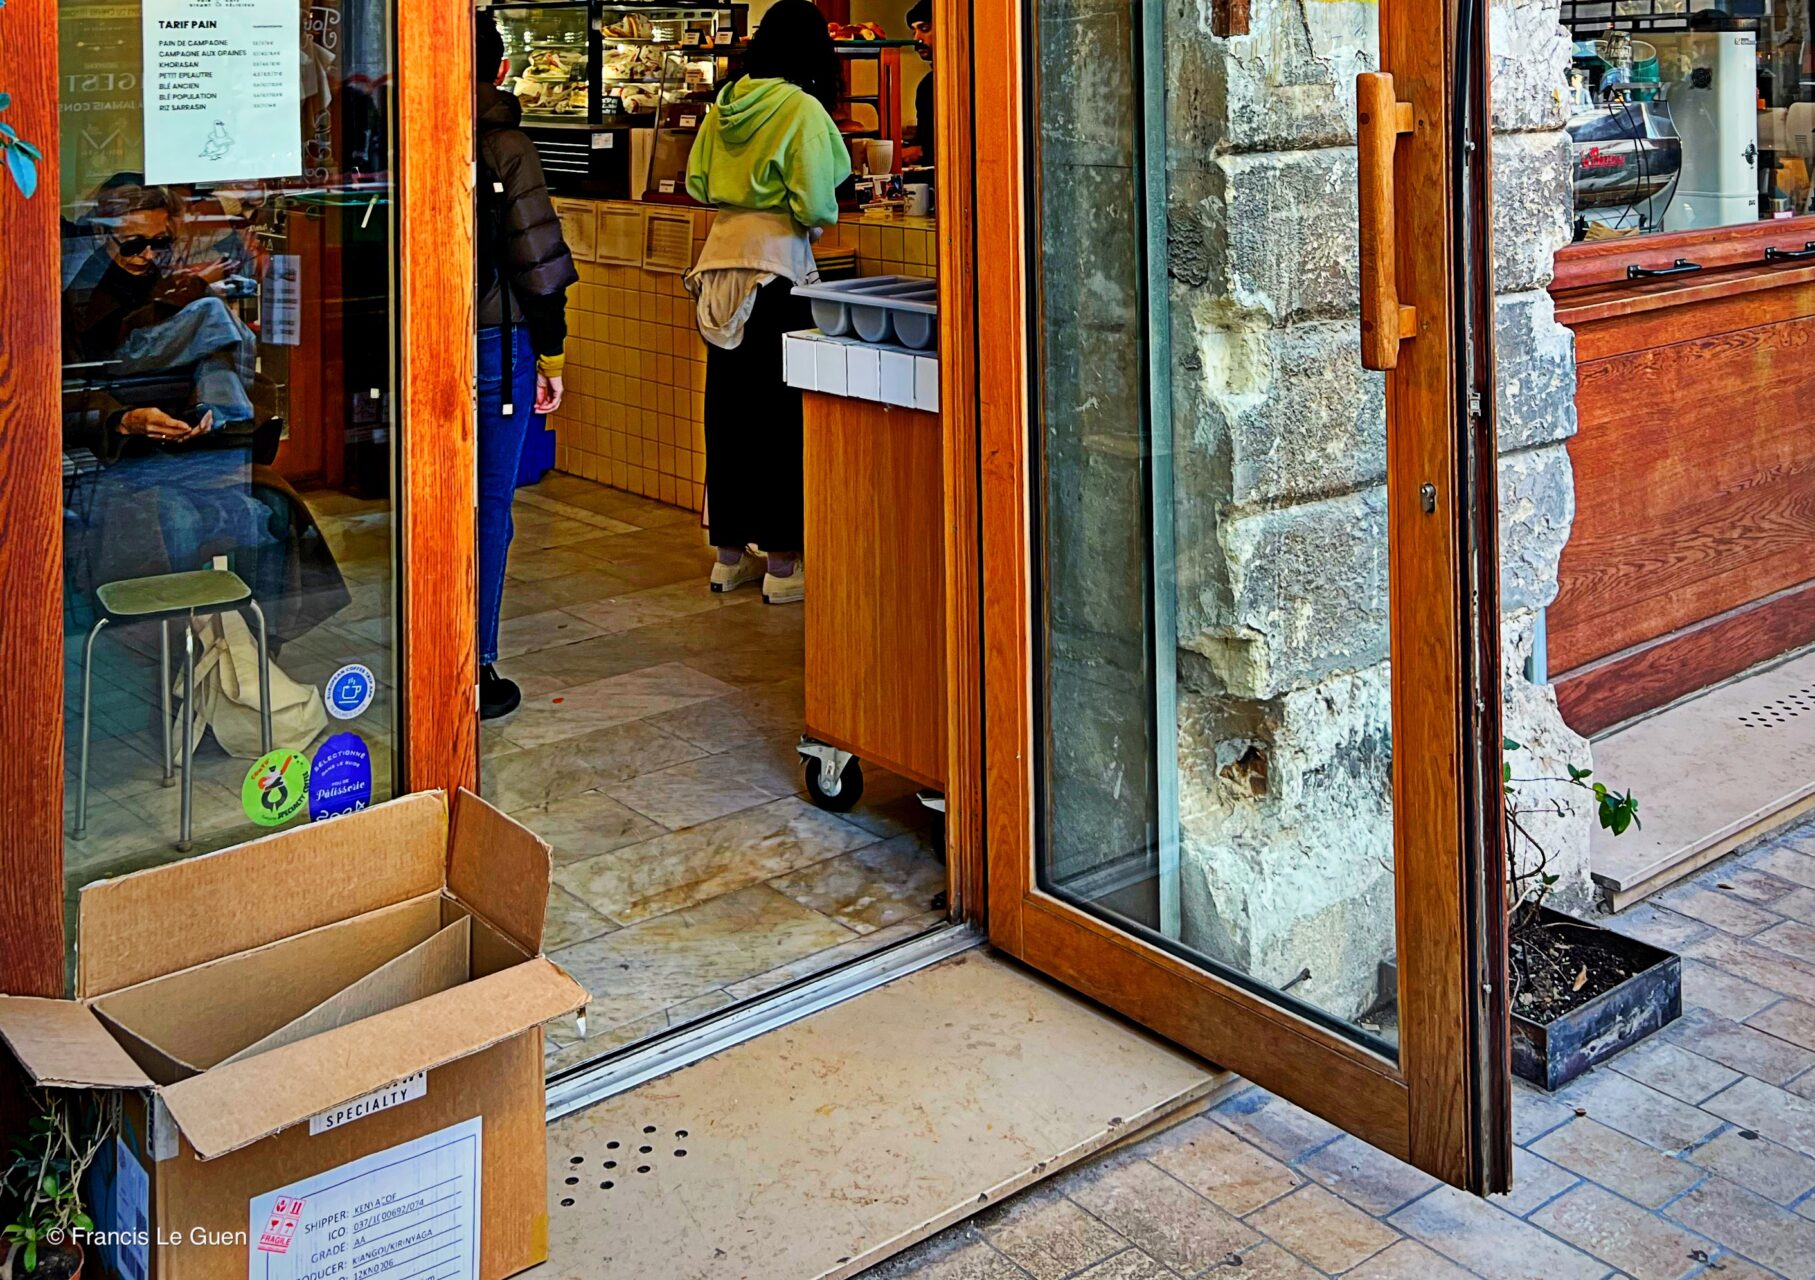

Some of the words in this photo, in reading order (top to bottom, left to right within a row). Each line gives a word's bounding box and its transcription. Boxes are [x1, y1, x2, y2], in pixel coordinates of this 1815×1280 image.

[158, 20, 189, 29] TARIF
[191, 20, 217, 29] PAIN
[217, 49, 247, 57] GRAINES
[158, 82, 170, 90] BLÉ
[172, 92, 217, 100] POPULATION
[171, 103, 206, 111] SARRASIN
[326, 1088, 408, 1128] SPECIALTY
[304, 1210, 349, 1235] SHIPPER:
[260, 1233, 292, 1246] FRAGILE
[311, 1241, 349, 1264] GRADE:
[354, 1235, 366, 1247] AA
[297, 1261, 348, 1280] ODUCER:
